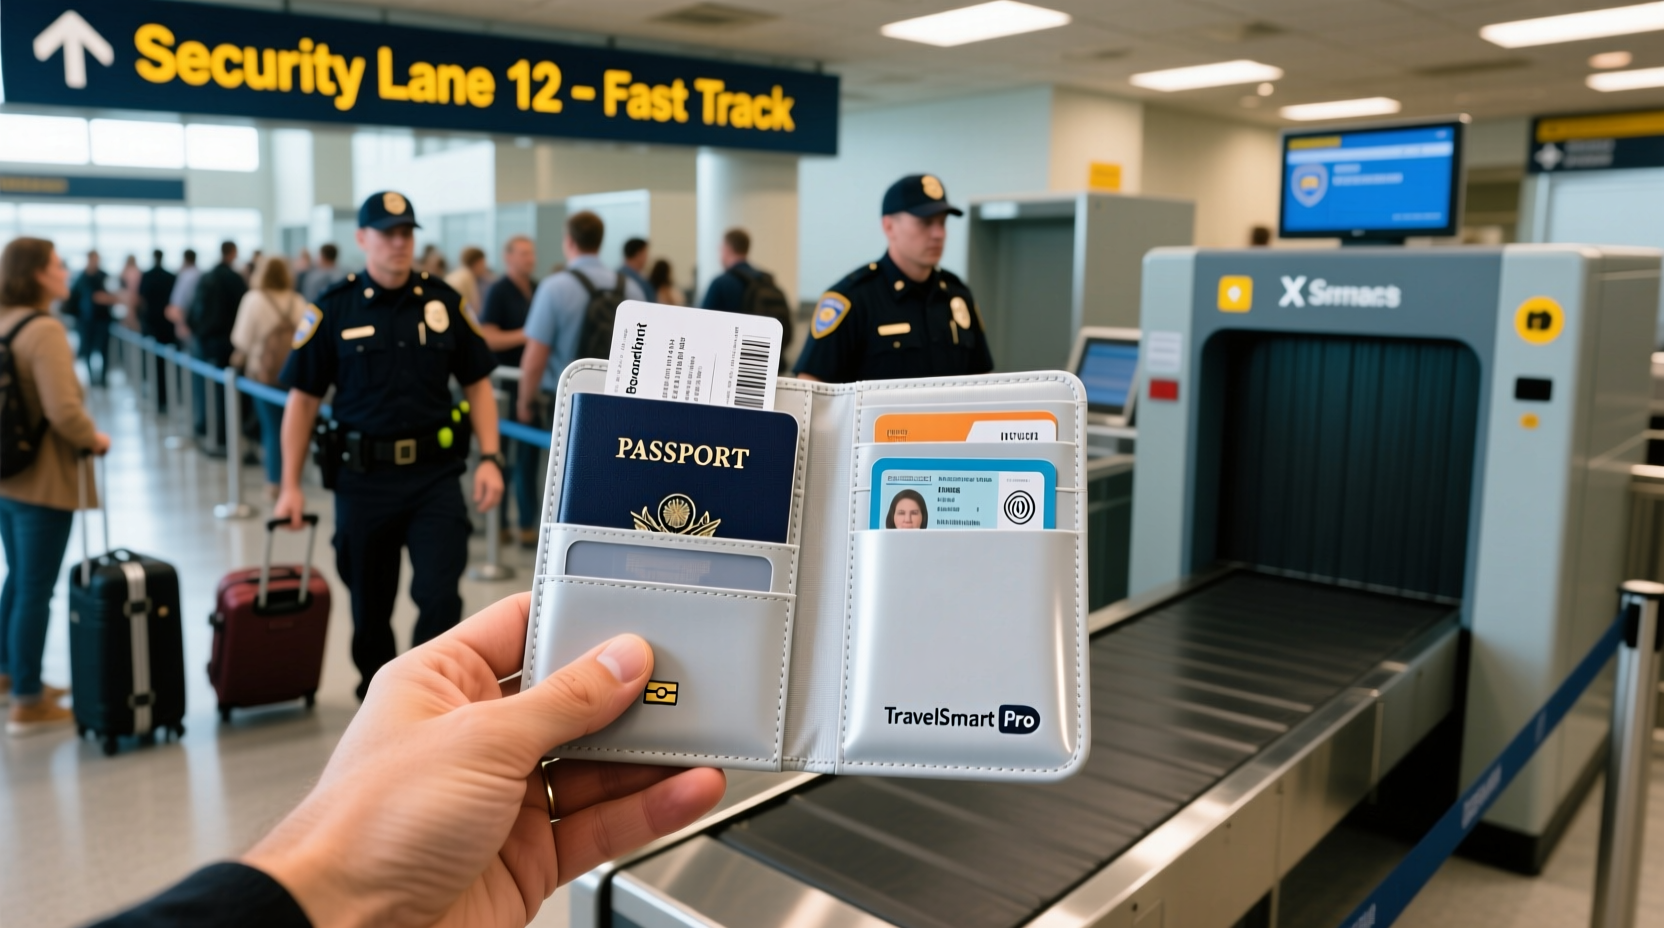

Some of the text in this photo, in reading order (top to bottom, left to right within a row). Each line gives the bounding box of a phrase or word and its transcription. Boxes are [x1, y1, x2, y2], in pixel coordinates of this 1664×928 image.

[134, 23, 366, 111] Security
[377, 45, 496, 108] Lane
[506, 58, 563, 113] 12
[603, 69, 689, 123] Fast
[693, 77, 796, 132] Track
[1278, 275, 1307, 308] X
[615, 437, 750, 469] PASSPORT
[884, 706, 1036, 728] TravelSmart Pro
